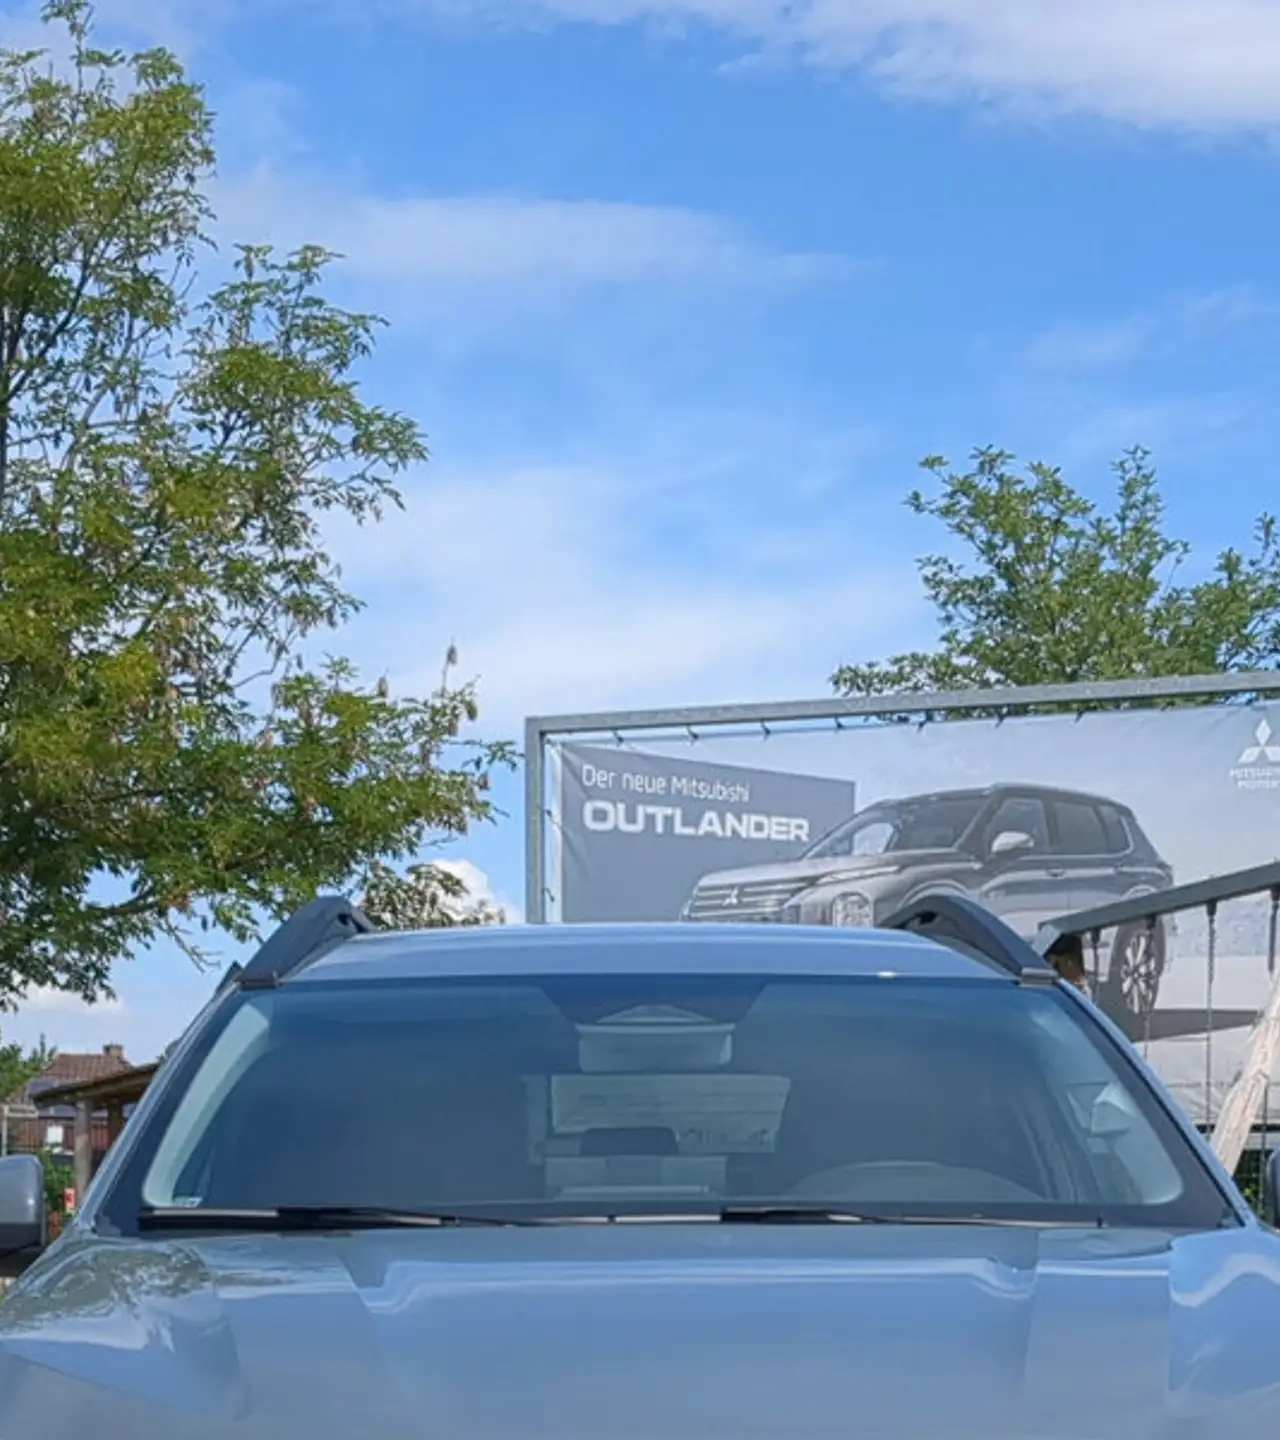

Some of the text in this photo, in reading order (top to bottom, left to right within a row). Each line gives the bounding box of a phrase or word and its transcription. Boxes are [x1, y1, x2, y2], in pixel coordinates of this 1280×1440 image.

[582, 763, 750, 803] Der neue Mitsubishi
[583, 800, 810, 842] OUTLANDER
